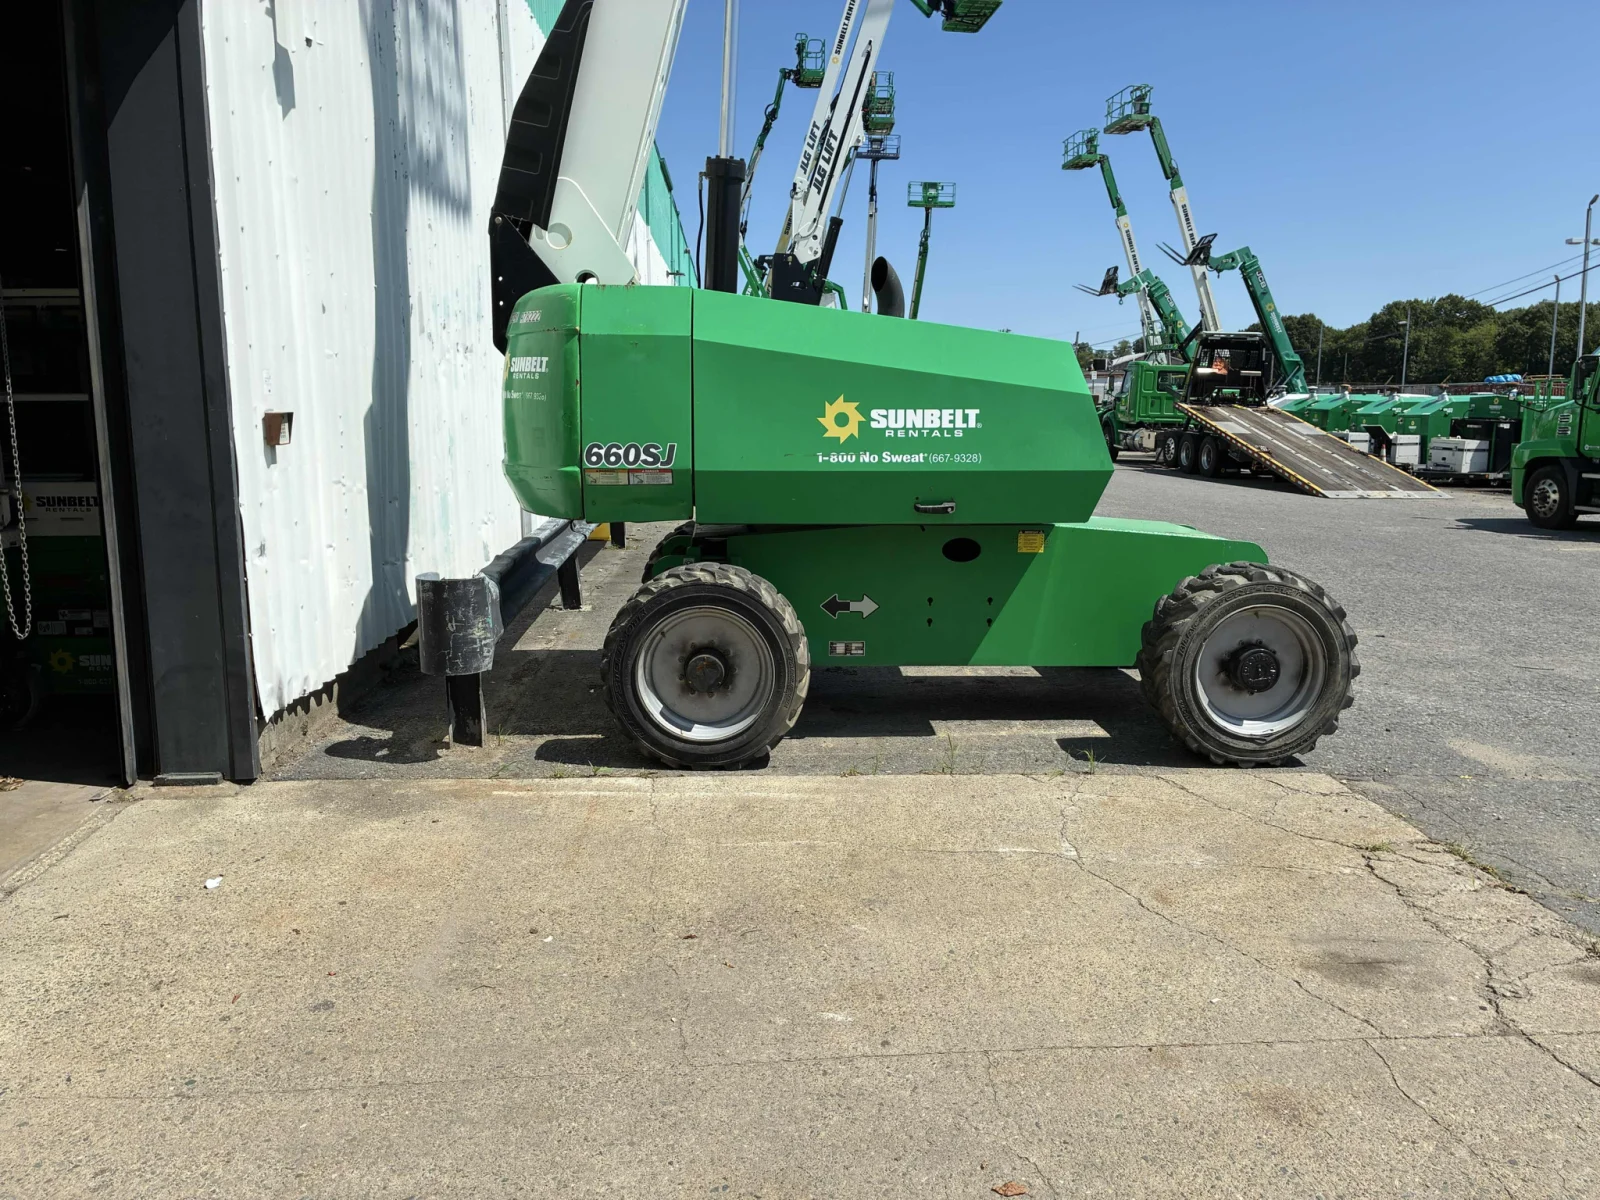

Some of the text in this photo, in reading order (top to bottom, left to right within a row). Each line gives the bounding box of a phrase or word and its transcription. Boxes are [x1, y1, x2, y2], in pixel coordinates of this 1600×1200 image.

[800, 120, 820, 175] JLG LIFT
[812, 128, 838, 196] JLG LIFT
[1256, 270, 1267, 289] JCB
[510, 356, 548, 373] SUNBELT
[512, 372, 540, 380] RENTALS
[870, 408, 980, 428] SUNBELT
[885, 429, 963, 438] RENTALS
[583, 441, 677, 468] 660SJ
[816, 452, 856, 463] 1-800
[859, 451, 879, 463] No
[928, 453, 982, 464] (667-9328)
[36, 495, 99, 507] SUNBELT
